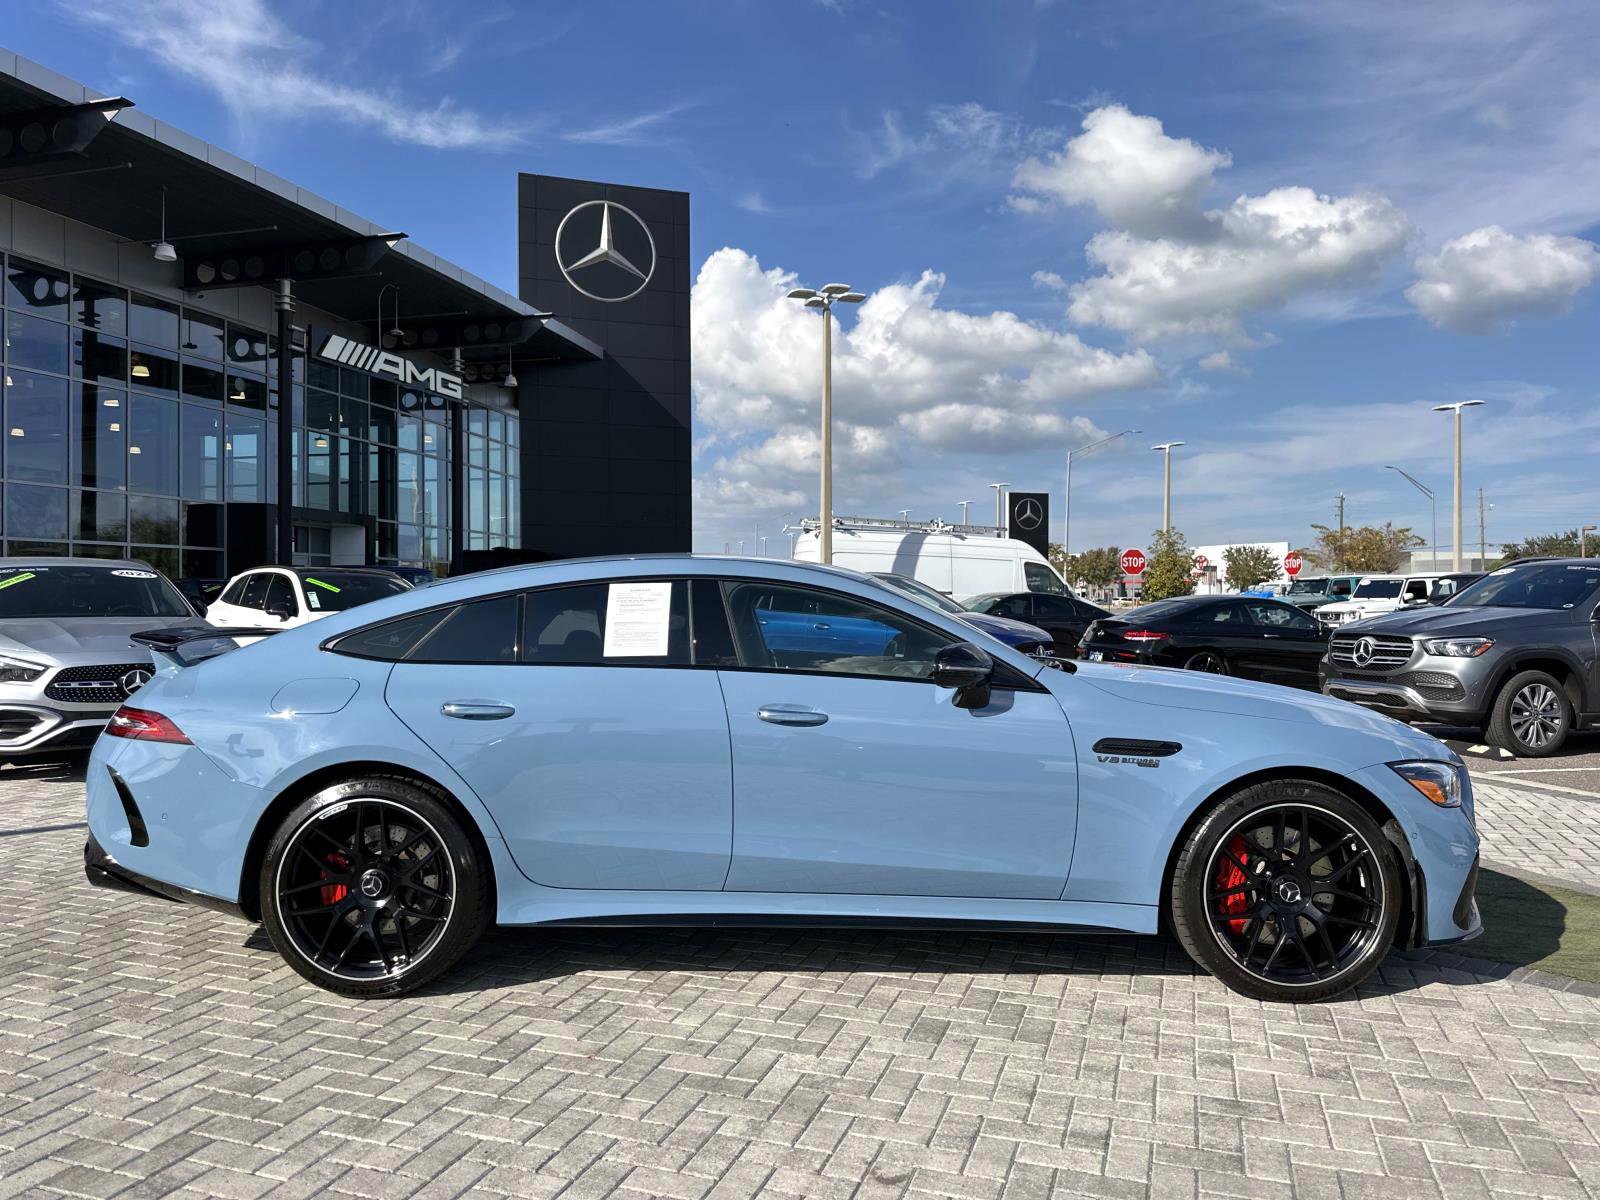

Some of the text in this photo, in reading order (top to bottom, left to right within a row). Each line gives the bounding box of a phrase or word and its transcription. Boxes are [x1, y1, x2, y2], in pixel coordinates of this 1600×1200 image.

[371, 351, 462, 400] AMG
[1122, 557, 1144, 568] STOP
[1284, 558, 1301, 569] STOP
[1097, 755, 1120, 764] V8
